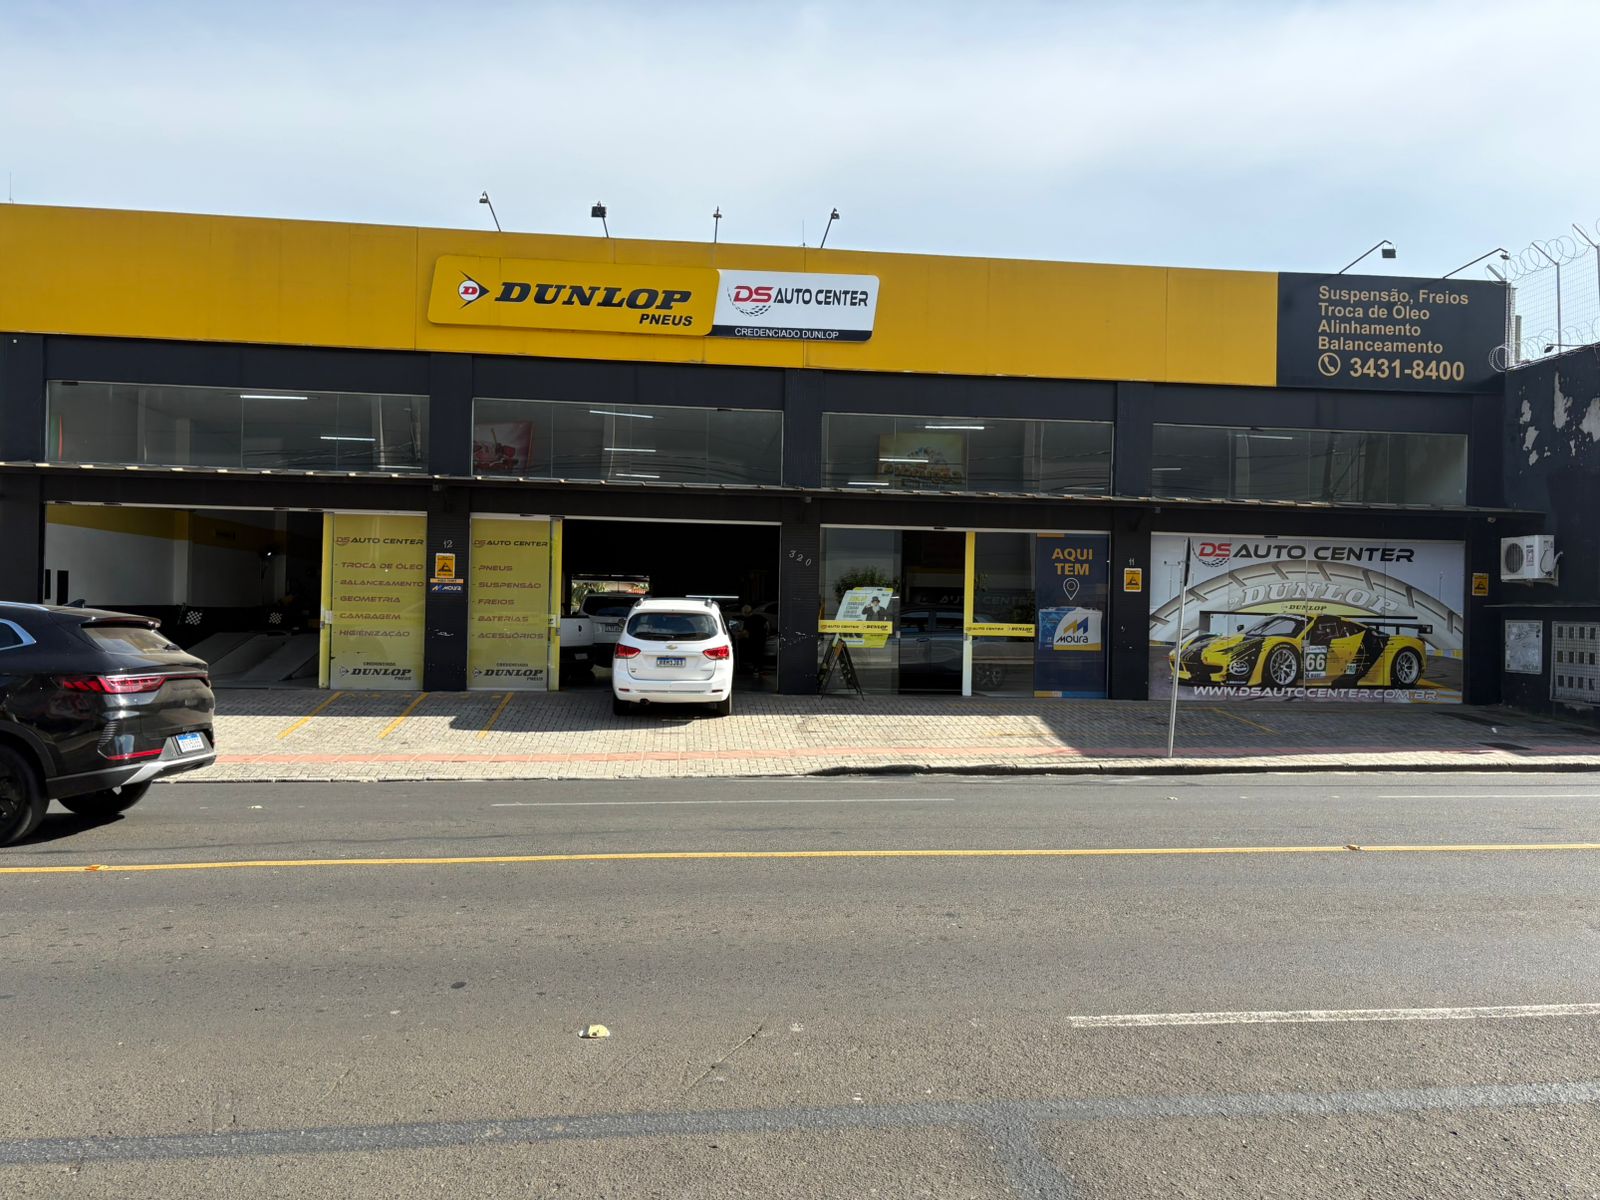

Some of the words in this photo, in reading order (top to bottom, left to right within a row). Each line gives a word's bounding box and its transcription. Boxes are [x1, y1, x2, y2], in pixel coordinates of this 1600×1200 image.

[494, 282, 692, 310] DUNLOP
[733, 285, 774, 303] DS
[773, 287, 812, 305] AUTO
[815, 289, 869, 307] CENTER
[1318, 286, 1414, 304] Suspensão,
[1418, 289, 1469, 305] Freios
[1318, 303, 1363, 318] Troca
[1368, 305, 1388, 319] de
[1392, 301, 1430, 320] Óleo
[639, 313, 693, 326] PNEUS
[734, 327, 800, 338] CREDENCIADO
[802, 330, 839, 339] DUNLOP
[1318, 320, 1421, 337] Alinhamento
[1318, 336, 1443, 354] Balanceamento
[1350, 357, 1465, 381] 3431-8400
[443, 539, 453, 549] 12
[1051, 548, 1093, 561] AQUI
[1199, 542, 1232, 557] DS
[1233, 543, 1307, 560] AUTO
[1313, 546, 1415, 563] CENTER
[1054, 563, 1089, 575] TEM
[340, 579, 424, 587] BALANCEAMENTO
[340, 595, 400, 603] GEOMETRIA
[1241, 582, 1400, 614] DUNLOP
[340, 612, 400, 620] CAMBAGEM
[1306, 653, 1326, 671] 66
[351, 668, 412, 676] DUNLOP
[484, 669, 544, 677] DUNLOP
